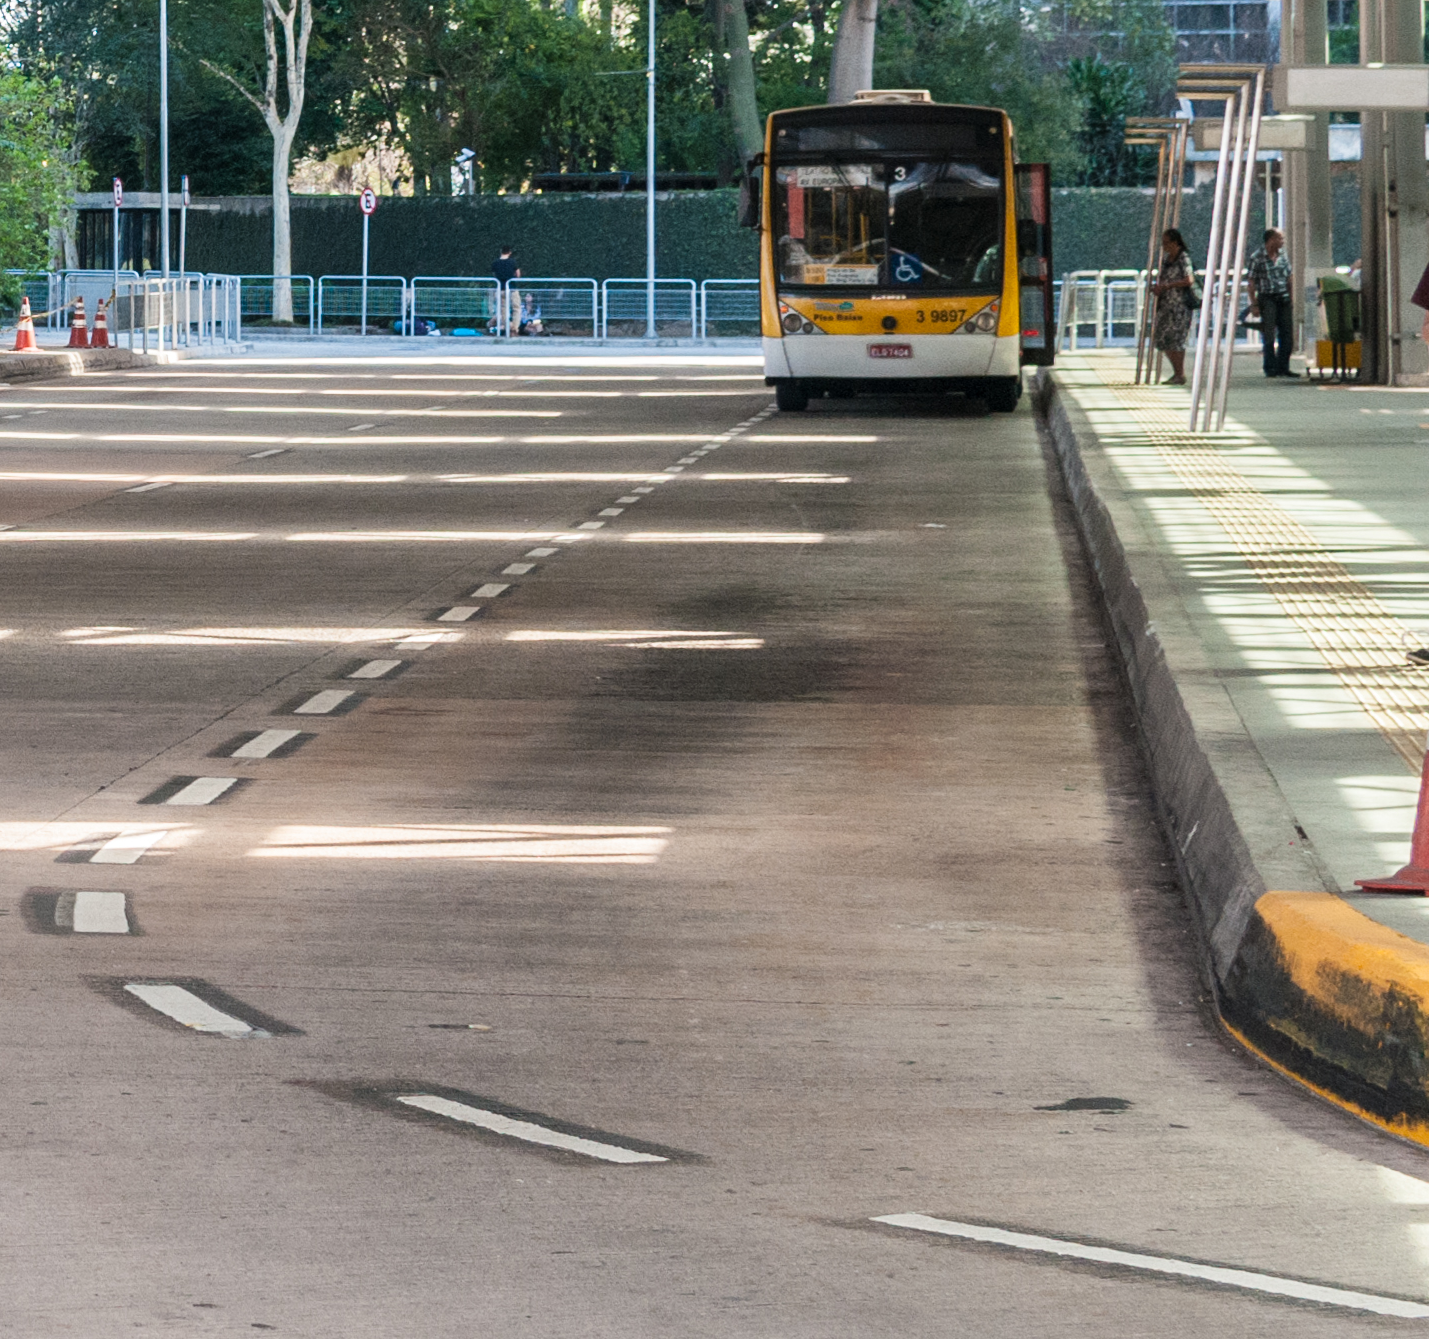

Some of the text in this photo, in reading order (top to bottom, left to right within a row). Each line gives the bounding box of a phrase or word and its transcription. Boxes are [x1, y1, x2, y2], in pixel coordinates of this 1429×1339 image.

[894, 166, 906, 181] 3
[916, 309, 967, 323] 3 9897
